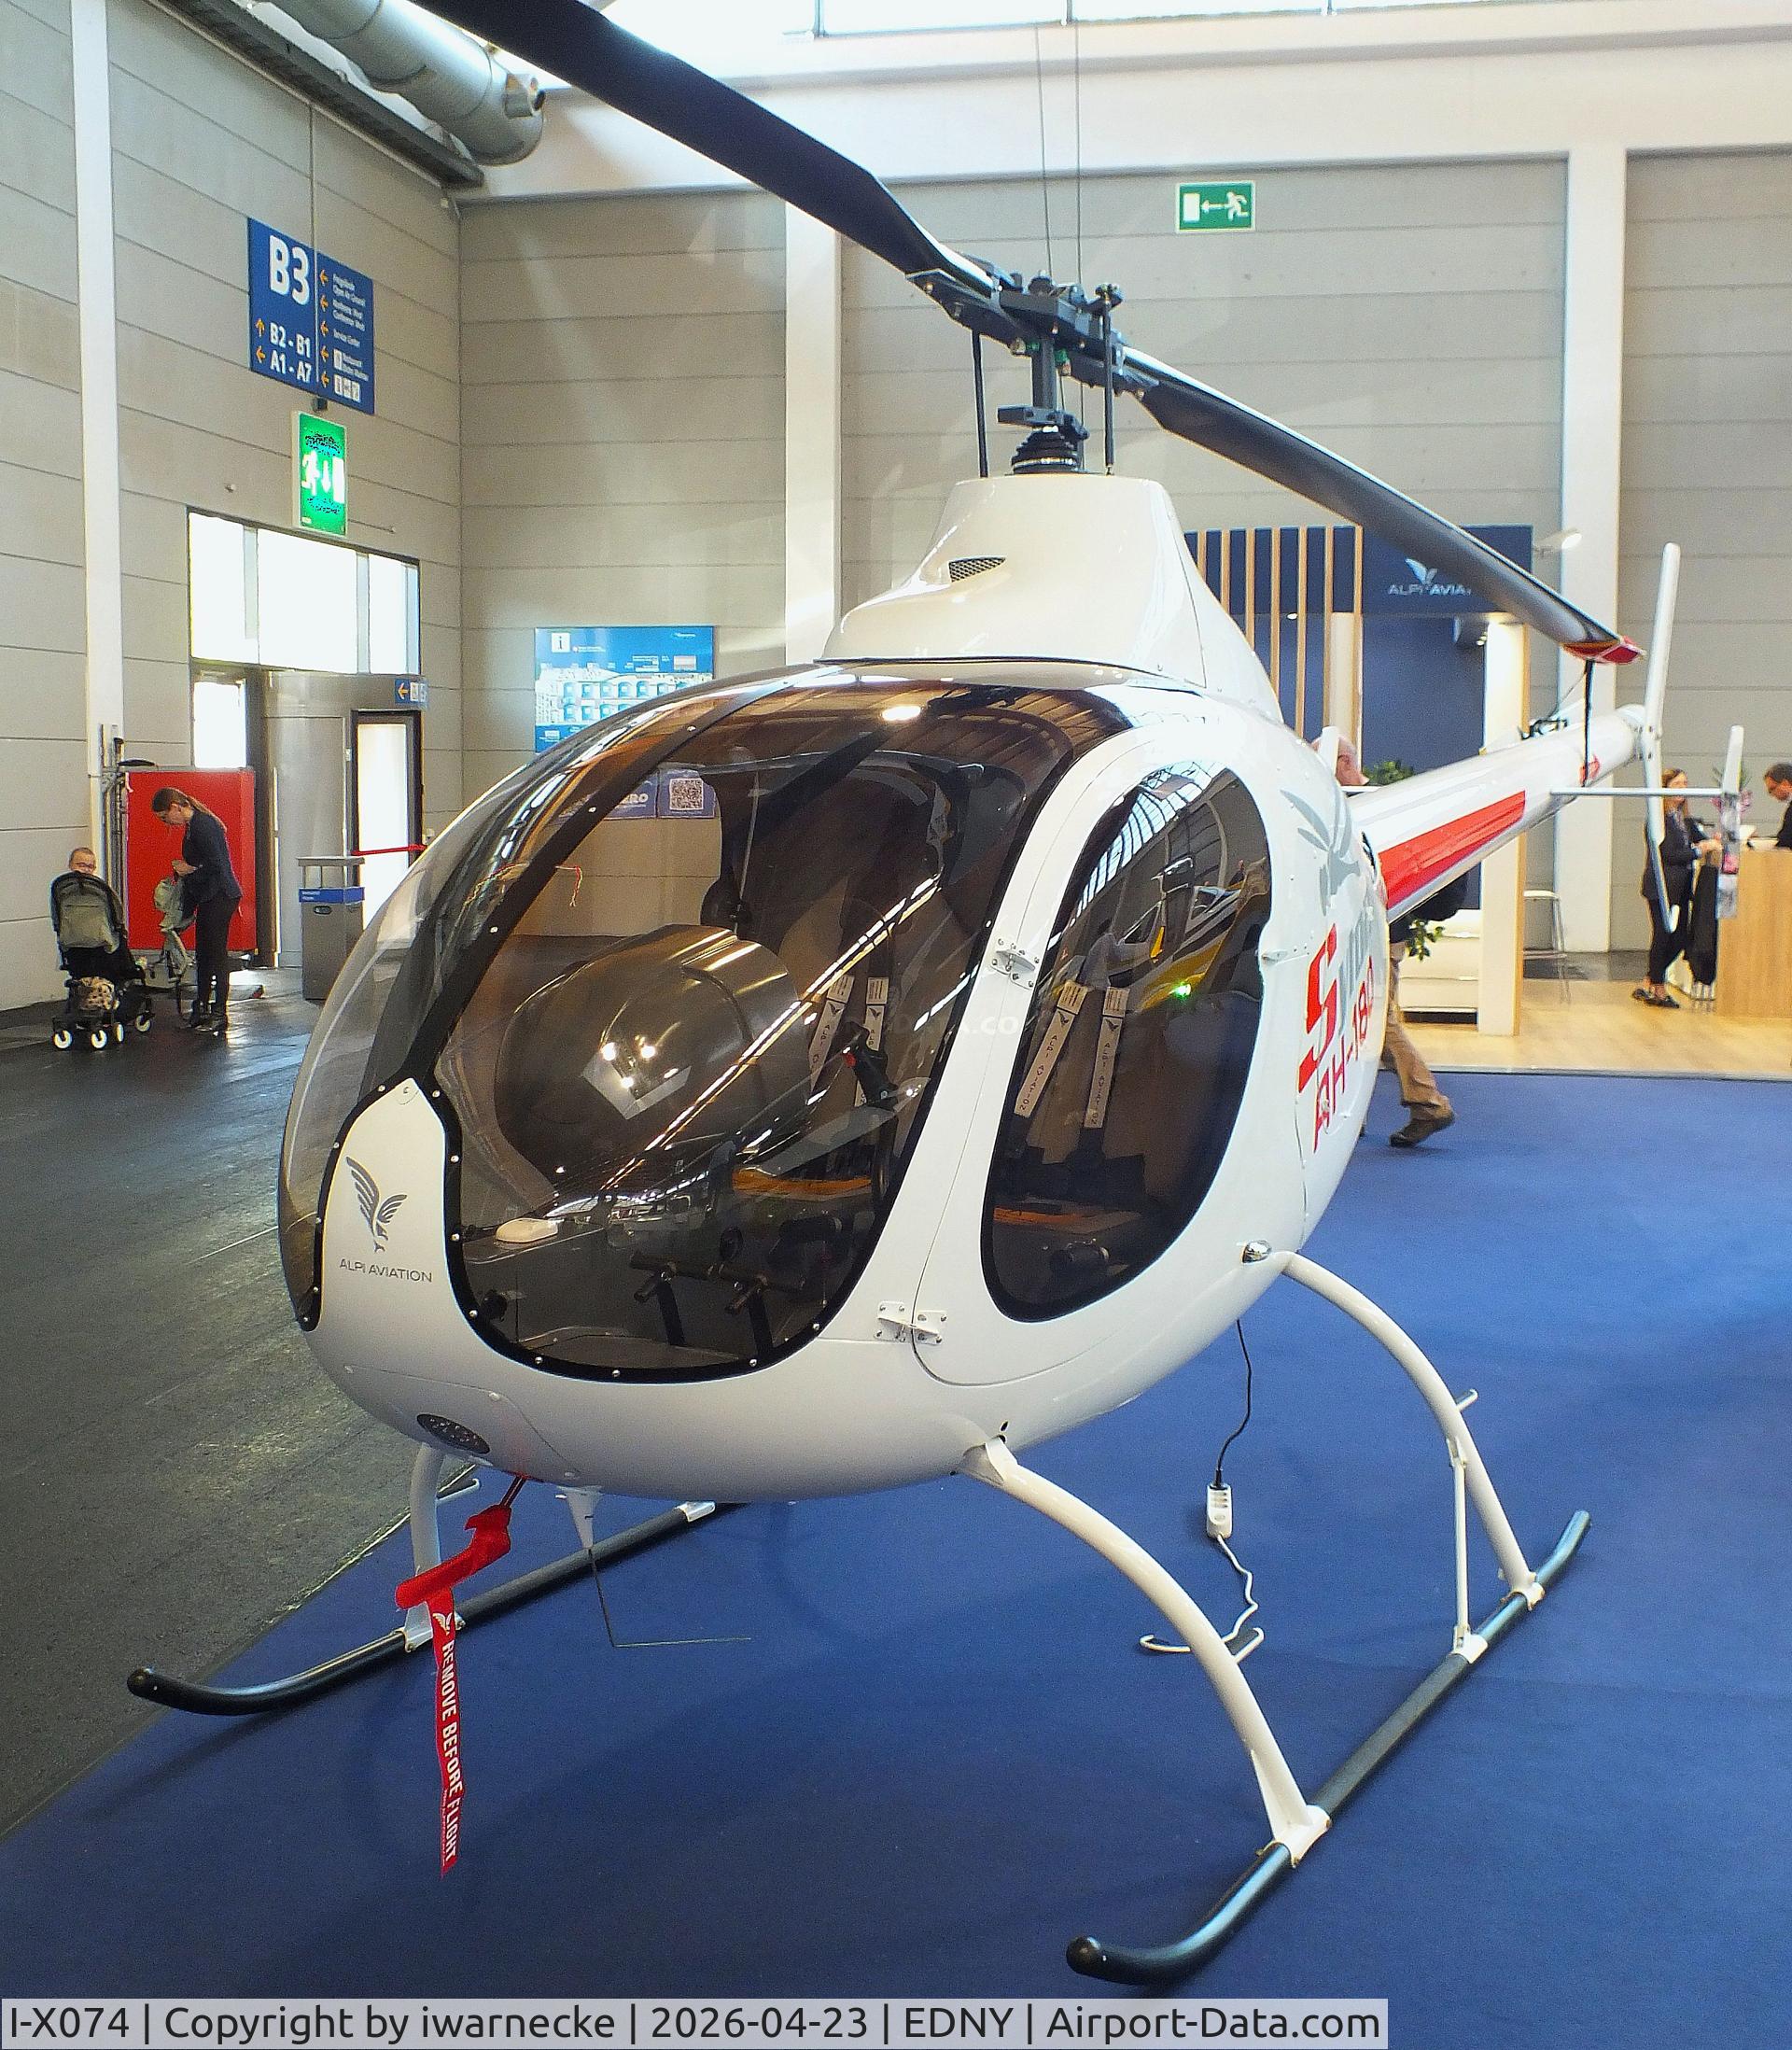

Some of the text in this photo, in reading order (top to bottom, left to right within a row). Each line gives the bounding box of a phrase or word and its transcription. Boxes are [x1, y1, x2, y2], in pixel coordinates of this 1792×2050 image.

[269, 234, 310, 305] B3
[270, 322, 286, 348] B2
[296, 333, 311, 358] B1
[270, 349, 287, 374] A1
[296, 360, 312, 383] A7
[1388, 583, 1423, 596] ALPI
[340, 1258, 432, 1283] ALPI AVIATION
[441, 1639, 463, 1861] REMOVE BEFORE FLIGHT
